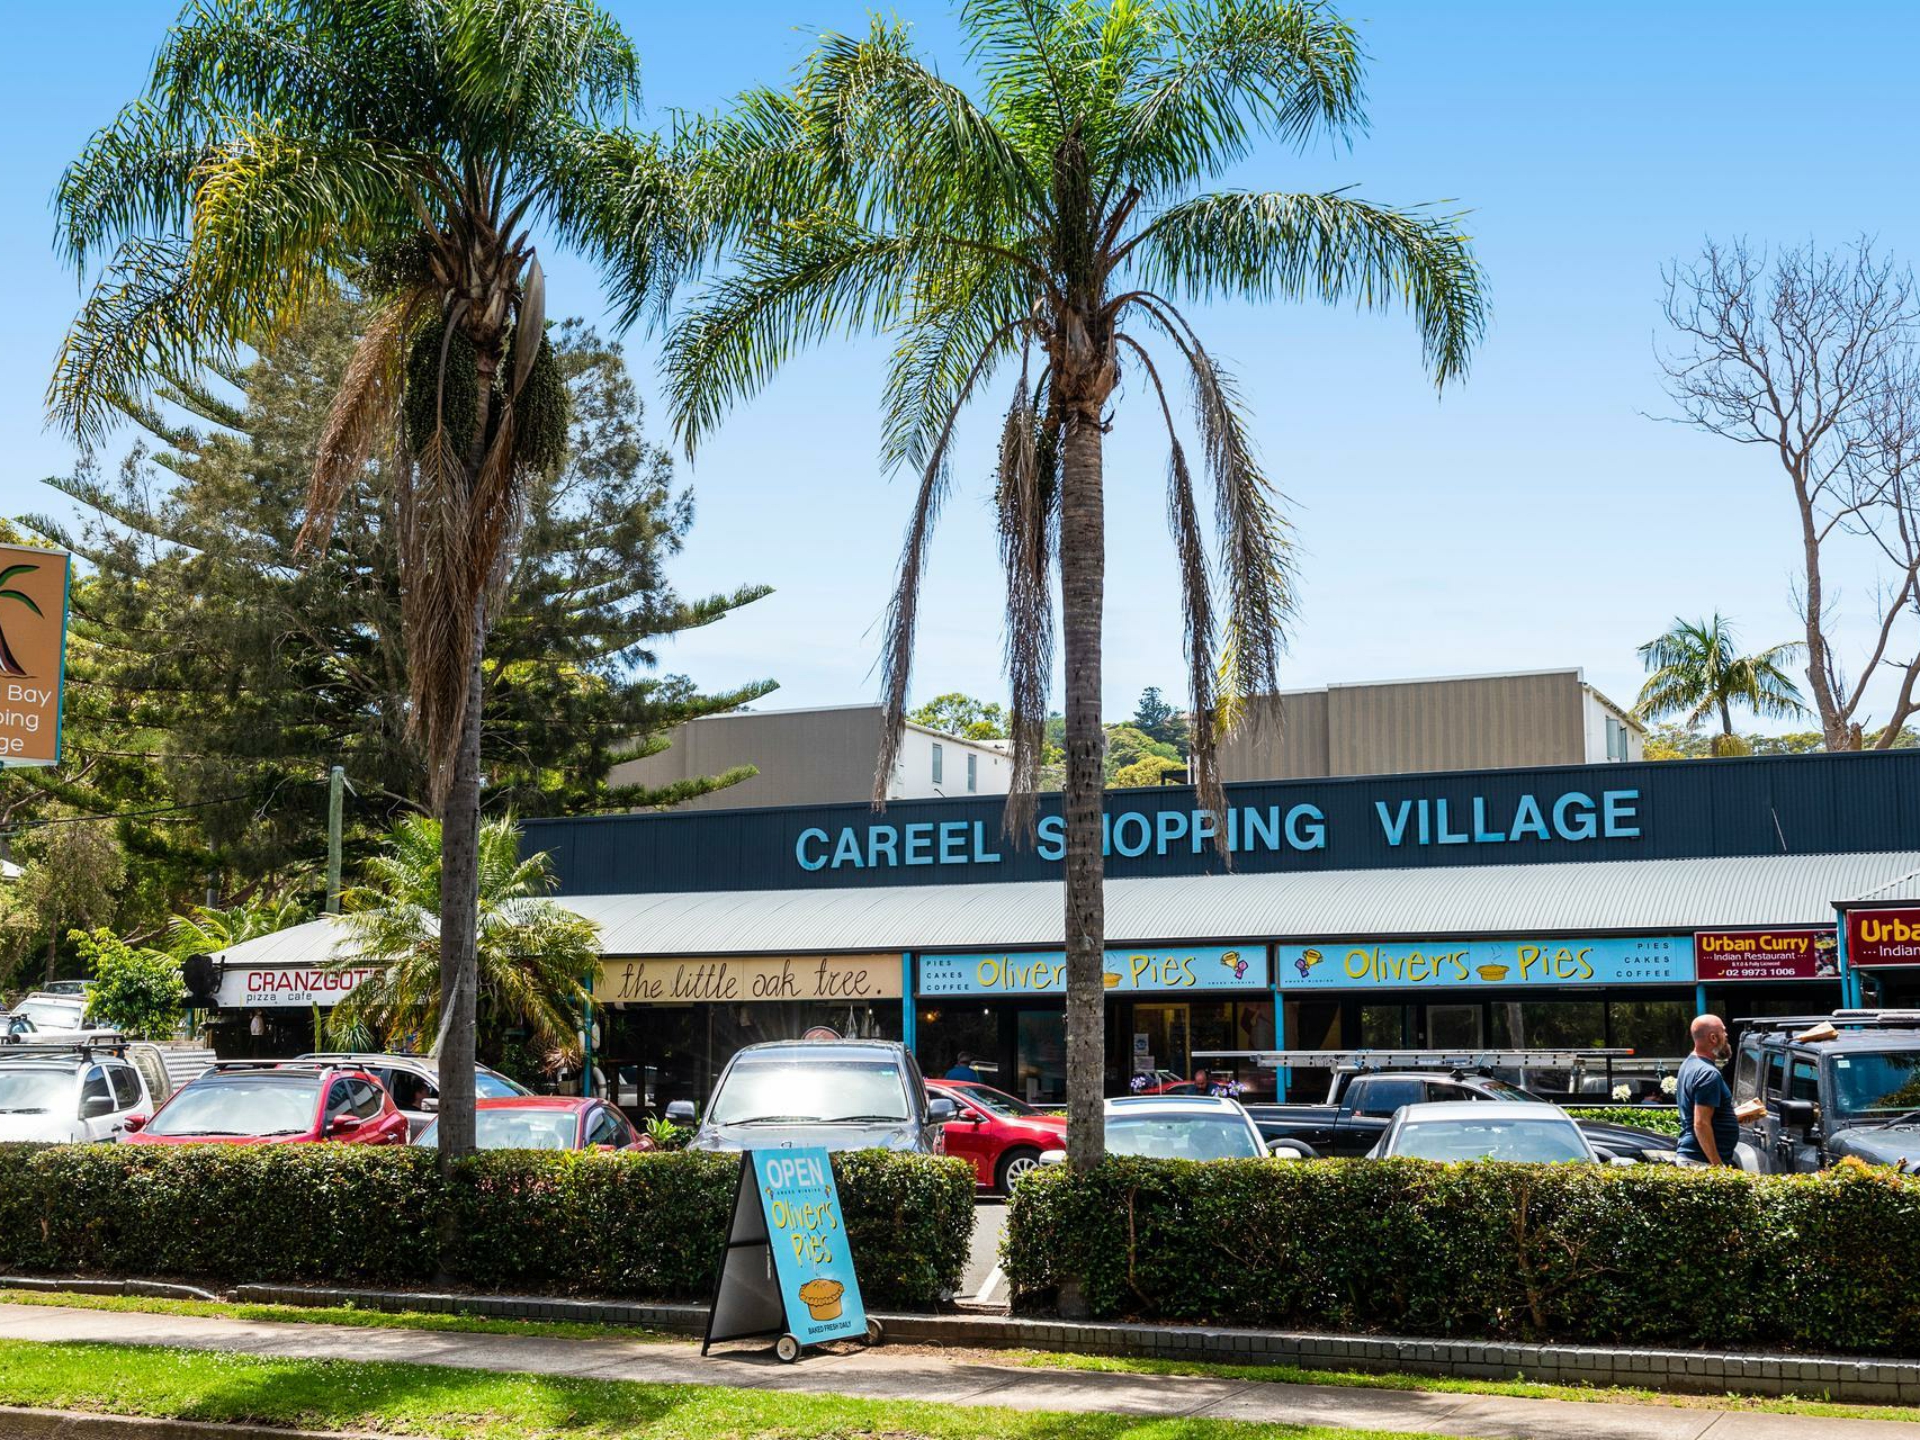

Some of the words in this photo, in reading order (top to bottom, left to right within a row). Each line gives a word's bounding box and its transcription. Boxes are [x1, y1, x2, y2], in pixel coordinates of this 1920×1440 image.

[8, 684, 52, 708] Bay
[796, 820, 1000, 871] CAREEL
[1037, 803, 1325, 861] SOPPING
[1375, 789, 1640, 847] VILLAGE
[1702, 935, 1756, 952] Urban
[1759, 934, 1809, 954] Curry
[1713, 953, 1742, 961] Indian
[1744, 952, 1796, 961] Restaurant
[1129, 954, 1197, 988] Pies
[1344, 946, 1470, 983] Oliver's
[1517, 944, 1595, 981] Pies
[1616, 969, 1670, 978] COFFEE
[1624, 955, 1670, 964] CAKES
[1741, 968, 1767, 976] 9973
[1770, 968, 1796, 976] 1006
[617, 962, 664, 999] the
[669, 962, 739, 999] little
[752, 959, 801, 998] oak
[246, 993, 277, 1004] pizza
[287, 991, 313, 1001] cafe
[766, 1157, 825, 1189] OPEN
[772, 1198, 838, 1231] Oliver's
[791, 1233, 833, 1269] Pies
